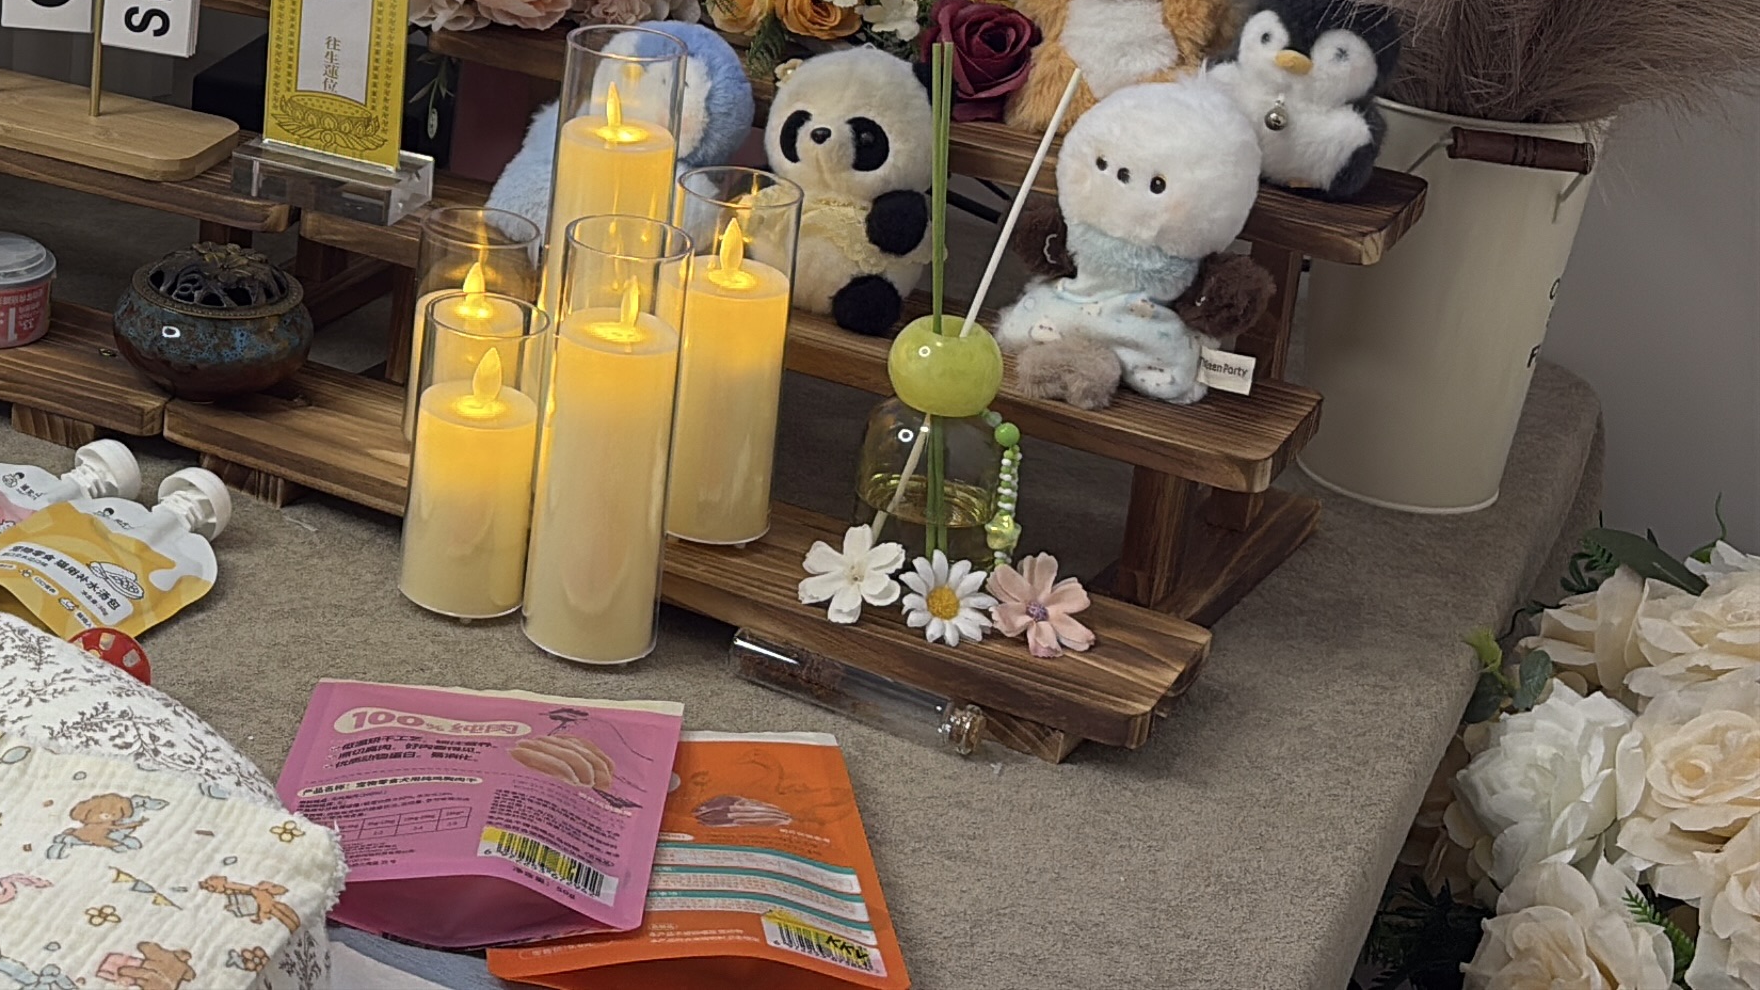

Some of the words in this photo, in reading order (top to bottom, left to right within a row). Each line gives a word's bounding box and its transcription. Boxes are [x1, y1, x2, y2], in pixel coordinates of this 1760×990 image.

[54, 559, 121, 610] 猫用补水汤包
